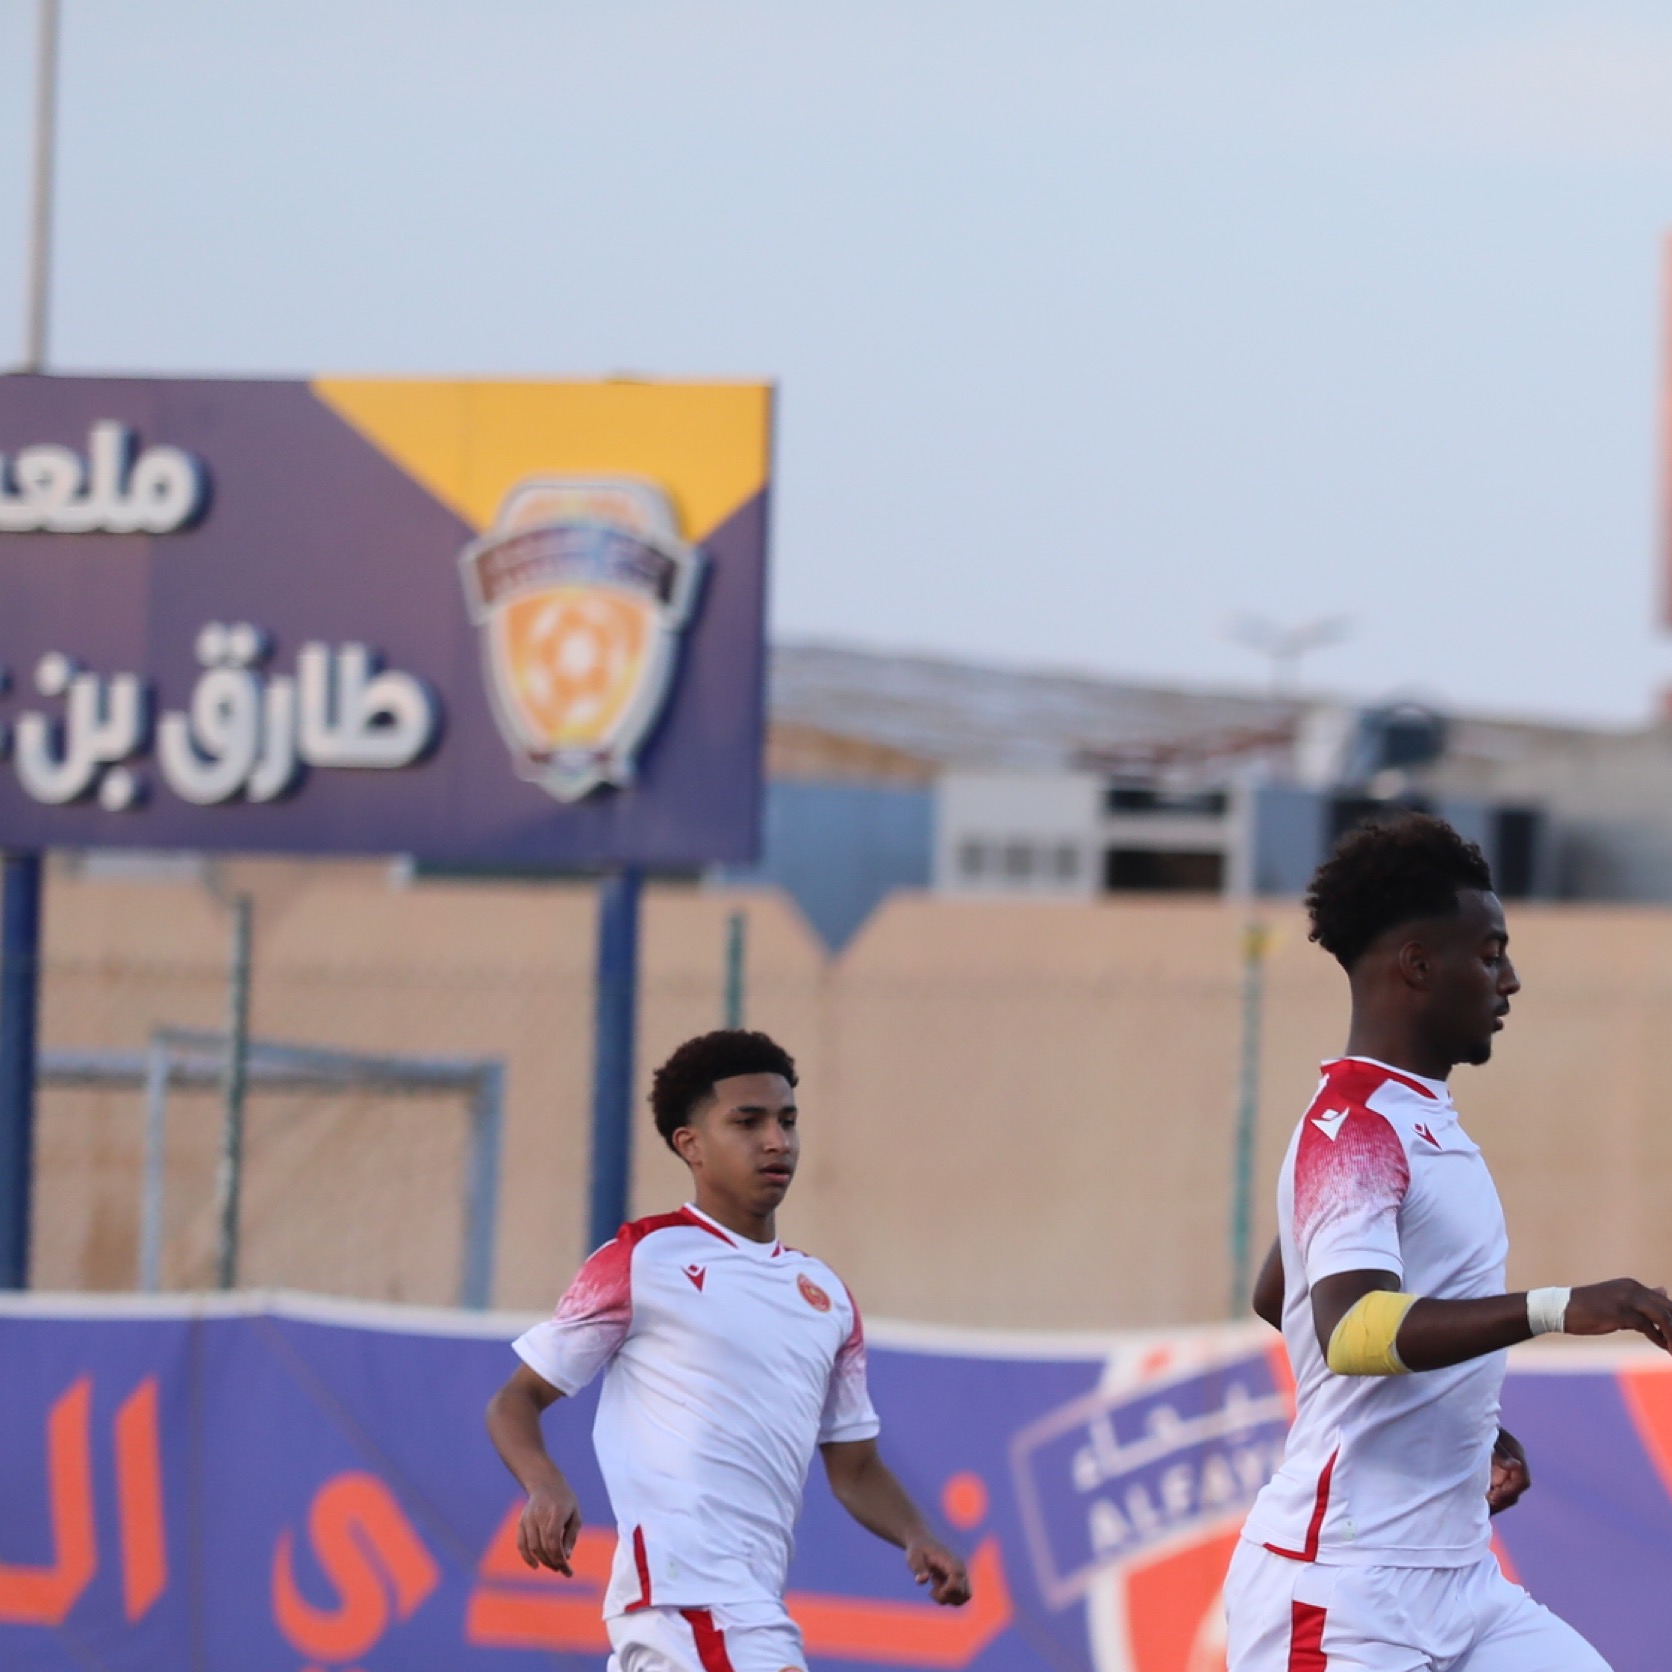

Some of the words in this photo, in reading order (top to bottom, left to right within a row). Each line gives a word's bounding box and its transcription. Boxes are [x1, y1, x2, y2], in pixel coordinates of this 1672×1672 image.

[0, 418, 198, 533] ملع
[14, 651, 143, 811] بن
[158, 622, 434, 806] طارق
